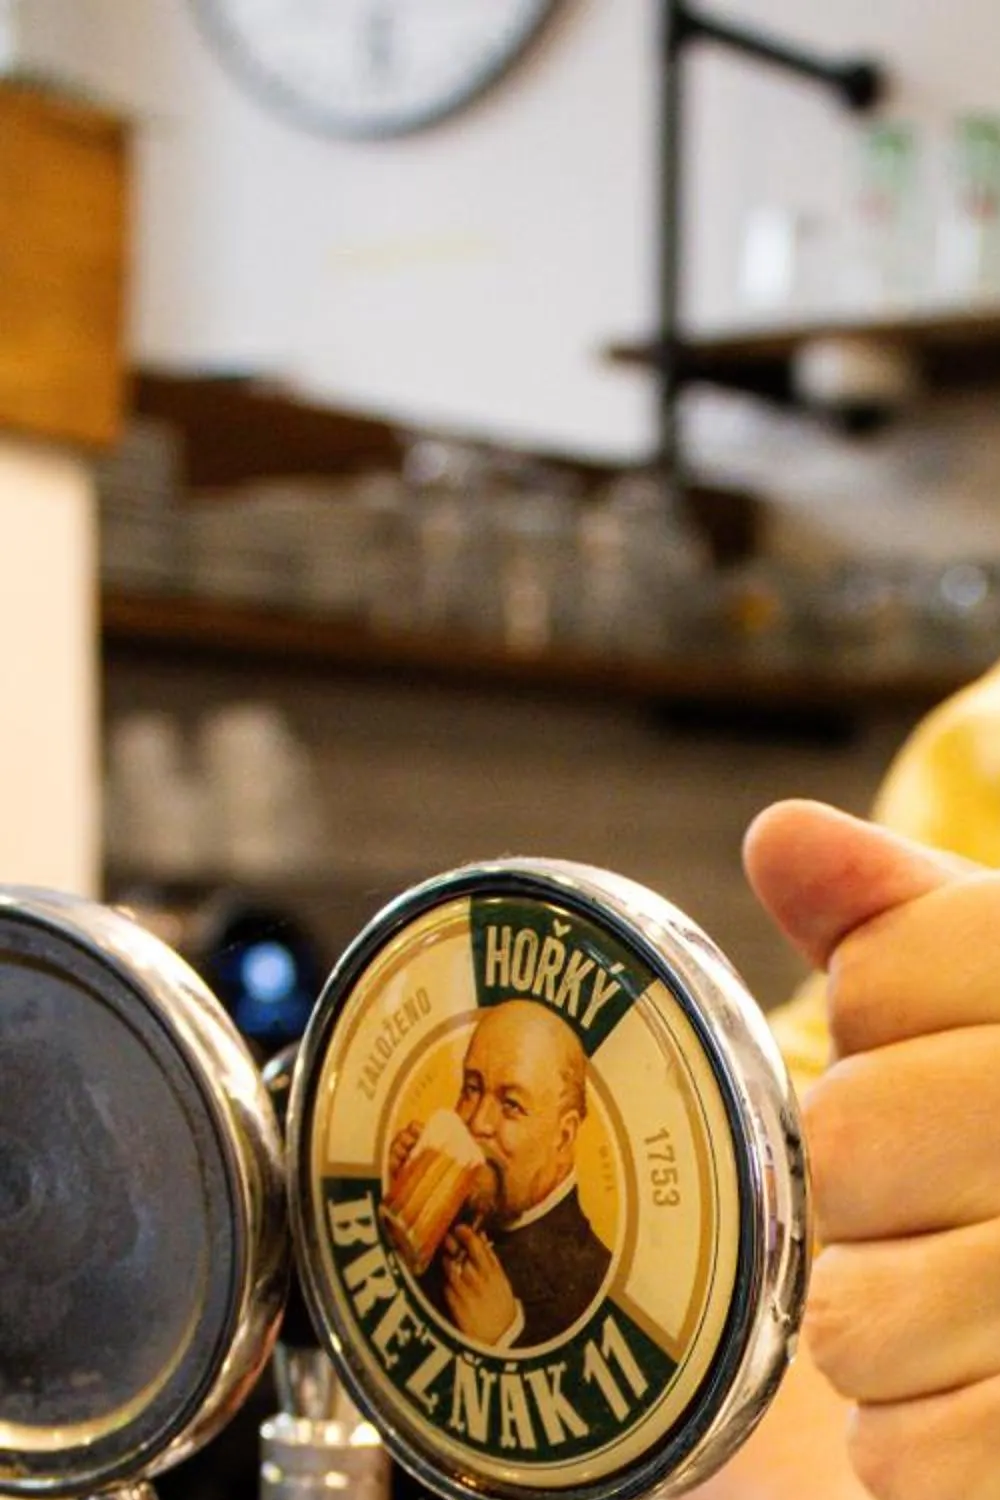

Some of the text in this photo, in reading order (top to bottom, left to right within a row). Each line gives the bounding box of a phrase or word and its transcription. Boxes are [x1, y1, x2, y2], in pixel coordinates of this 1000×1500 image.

[484, 917, 626, 1031] HOŘKÝ
[356, 986, 433, 1101] ZALOŽENO
[643, 1127, 681, 1207] 1753
[327, 1189, 650, 1451] BŘEZŇÁK 11
